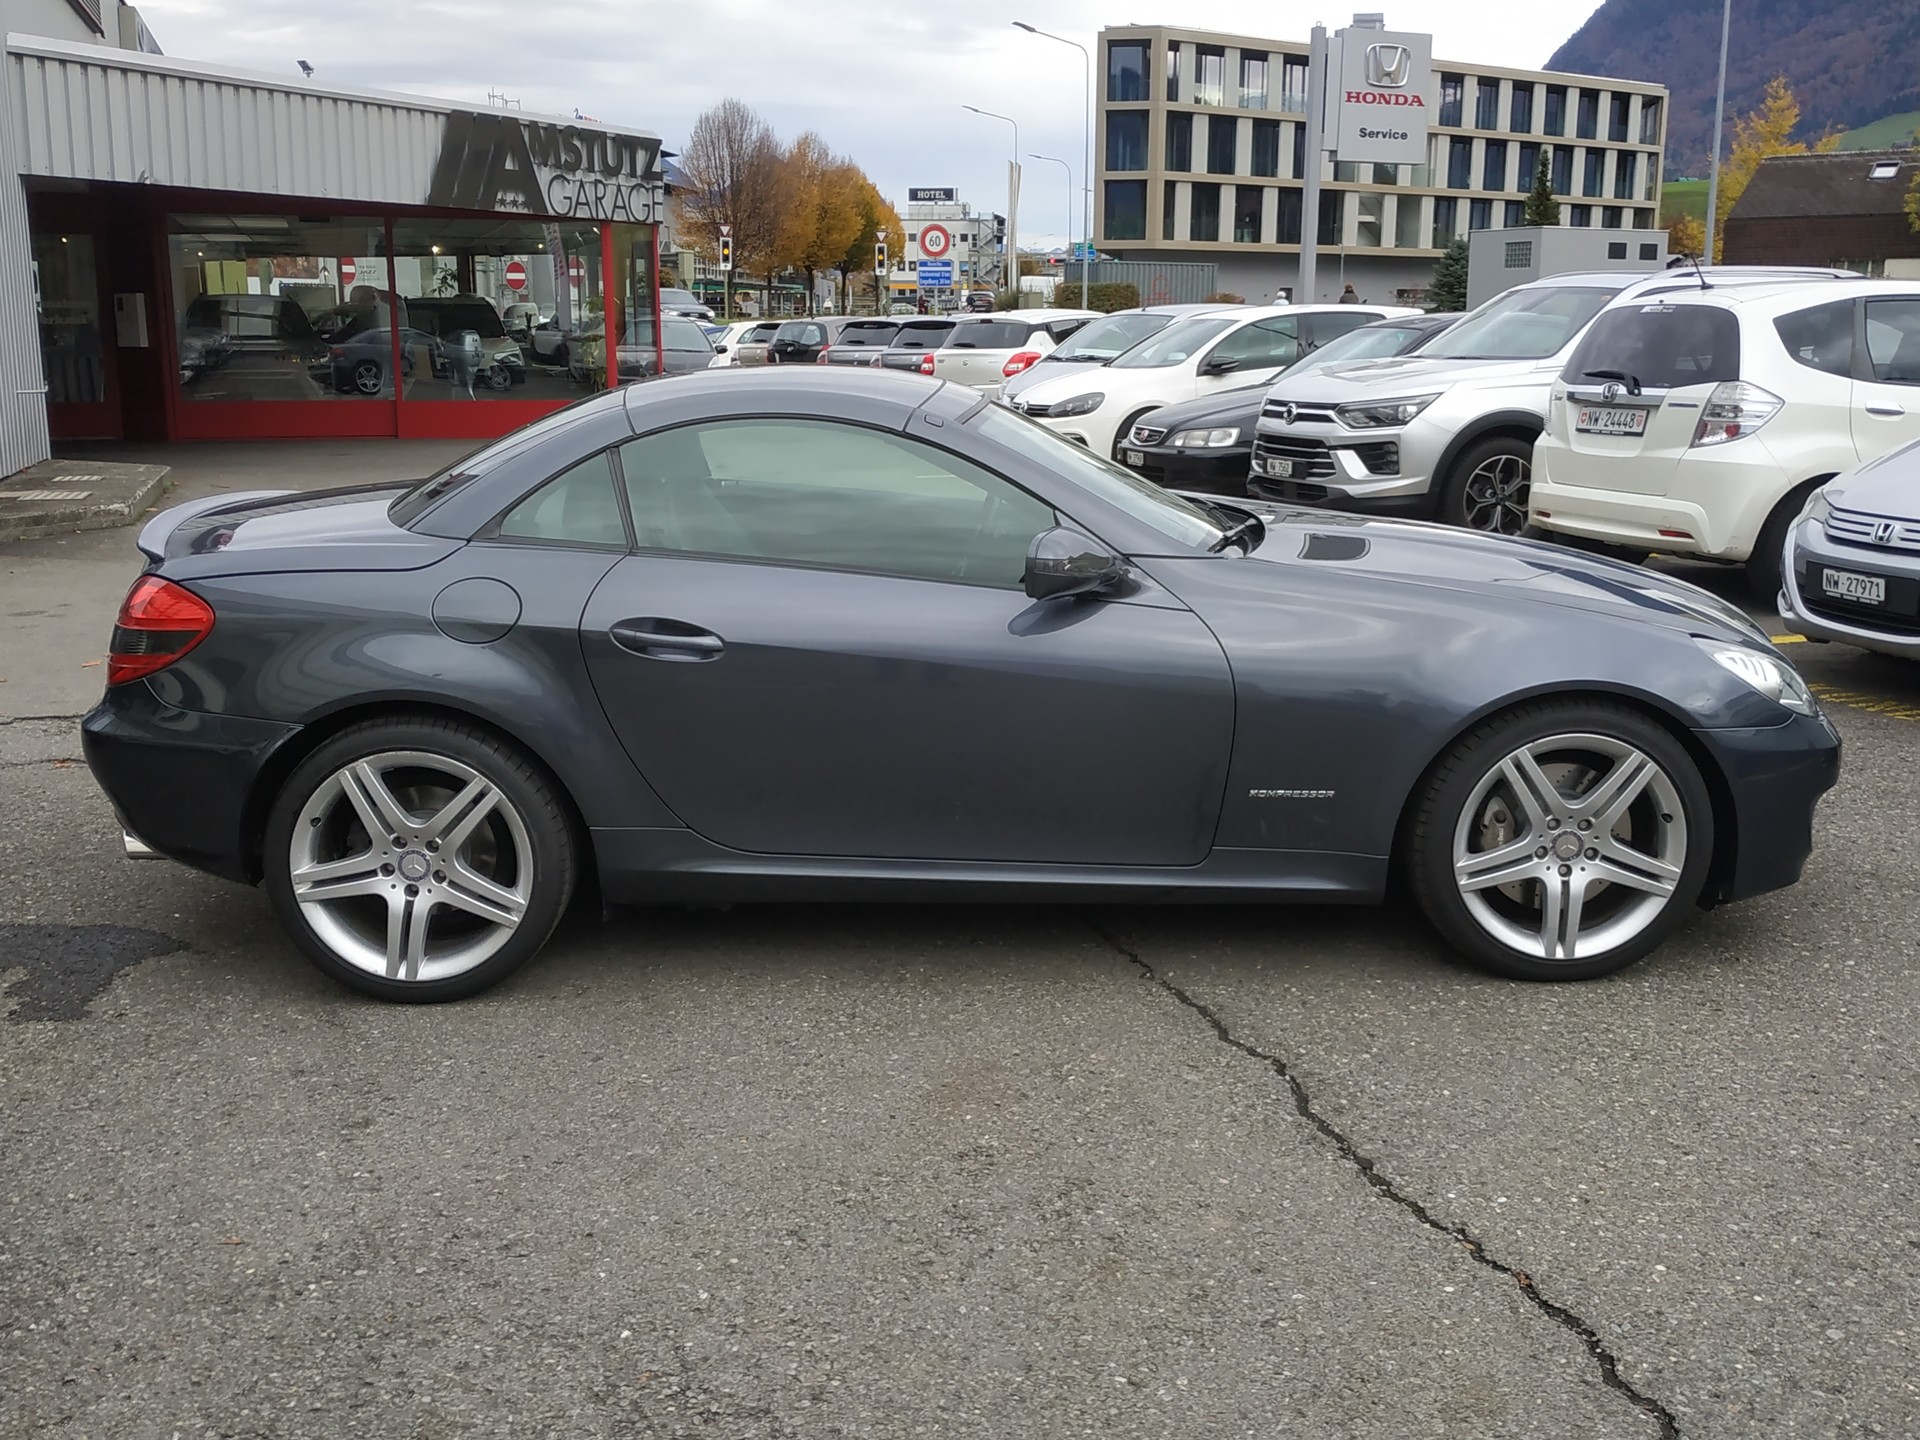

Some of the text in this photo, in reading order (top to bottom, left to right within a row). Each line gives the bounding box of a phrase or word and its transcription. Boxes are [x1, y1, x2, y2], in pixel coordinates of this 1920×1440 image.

[1345, 91, 1425, 107] HONDA
[1359, 128, 1408, 140] Service
[476, 118, 663, 214] AMSTUTZ
[547, 174, 664, 224] GARAGE
[917, 190, 946, 199] HOTEL
[929, 235, 941, 248] 60
[1248, 789, 1335, 798] KOMPRESSOR
